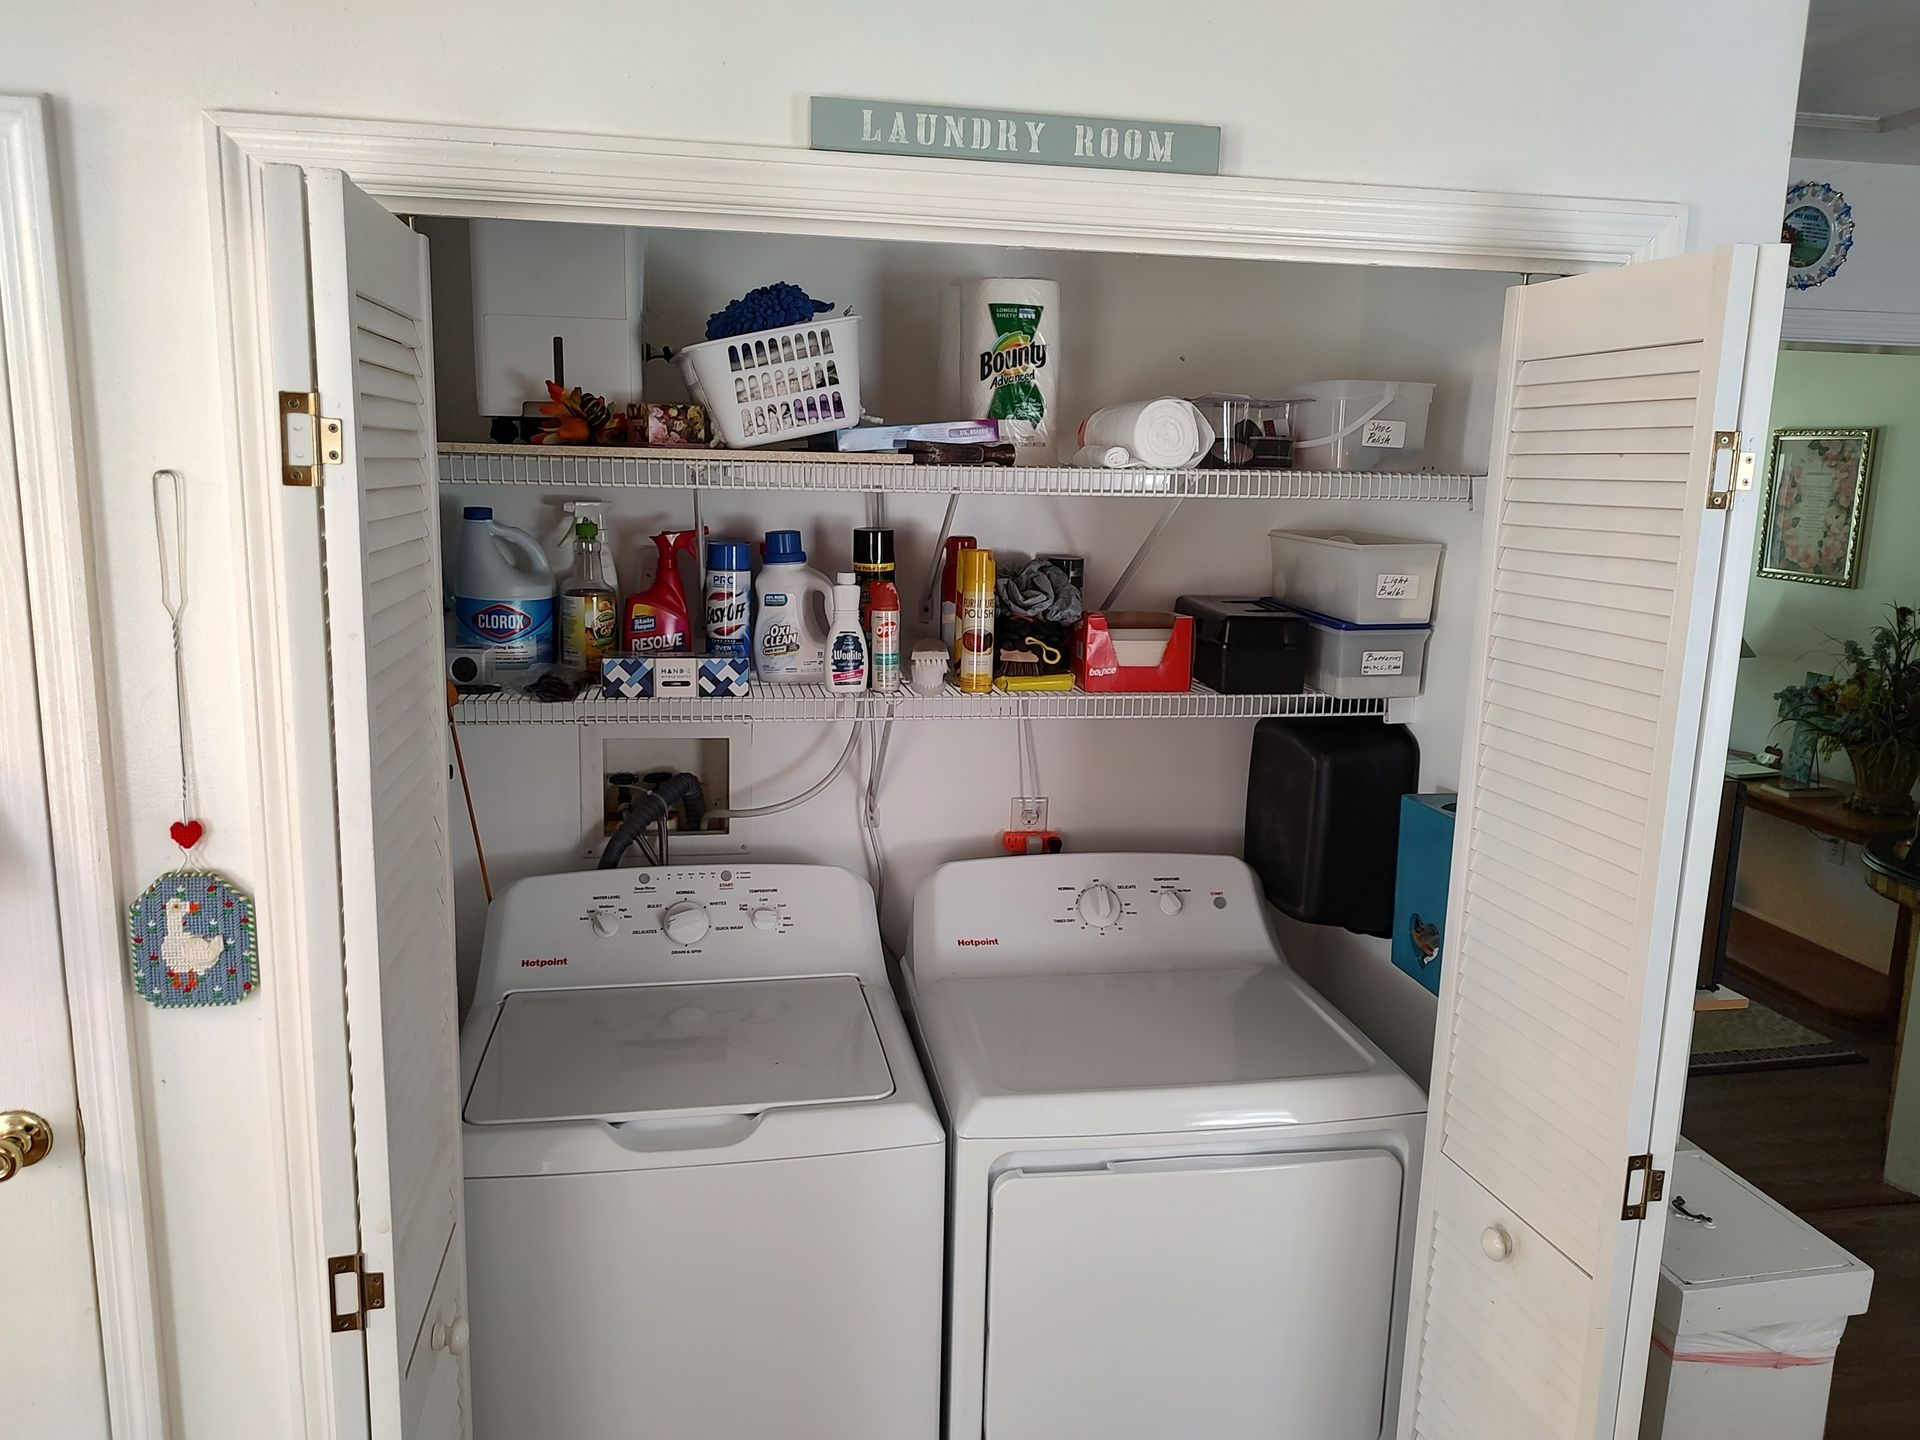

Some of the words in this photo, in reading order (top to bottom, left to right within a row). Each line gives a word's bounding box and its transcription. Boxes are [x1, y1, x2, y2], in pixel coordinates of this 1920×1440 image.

[861, 108, 1046, 154] LAUNDRY
[1073, 124, 1175, 163] ROOM
[980, 341, 1047, 382] Bounty
[990, 369, 1036, 390] Advanced
[1369, 421, 1392, 433] Shoe
[1366, 432, 1391, 445] Polish
[1383, 575, 1409, 588] Light
[1378, 585, 1406, 597] Bulbs
[477, 614, 525, 629] CLOROX
[769, 624, 791, 637] OXI
[876, 622, 897, 636] OFF!
[632, 632, 684, 653] RESOLVE
[763, 633, 798, 648] CLEAN
[833, 650, 862, 661] Woolite
[1088, 666, 1117, 677] bounce
[957, 937, 1000, 947] Hotpoint
[521, 957, 568, 968] Hotpoint
